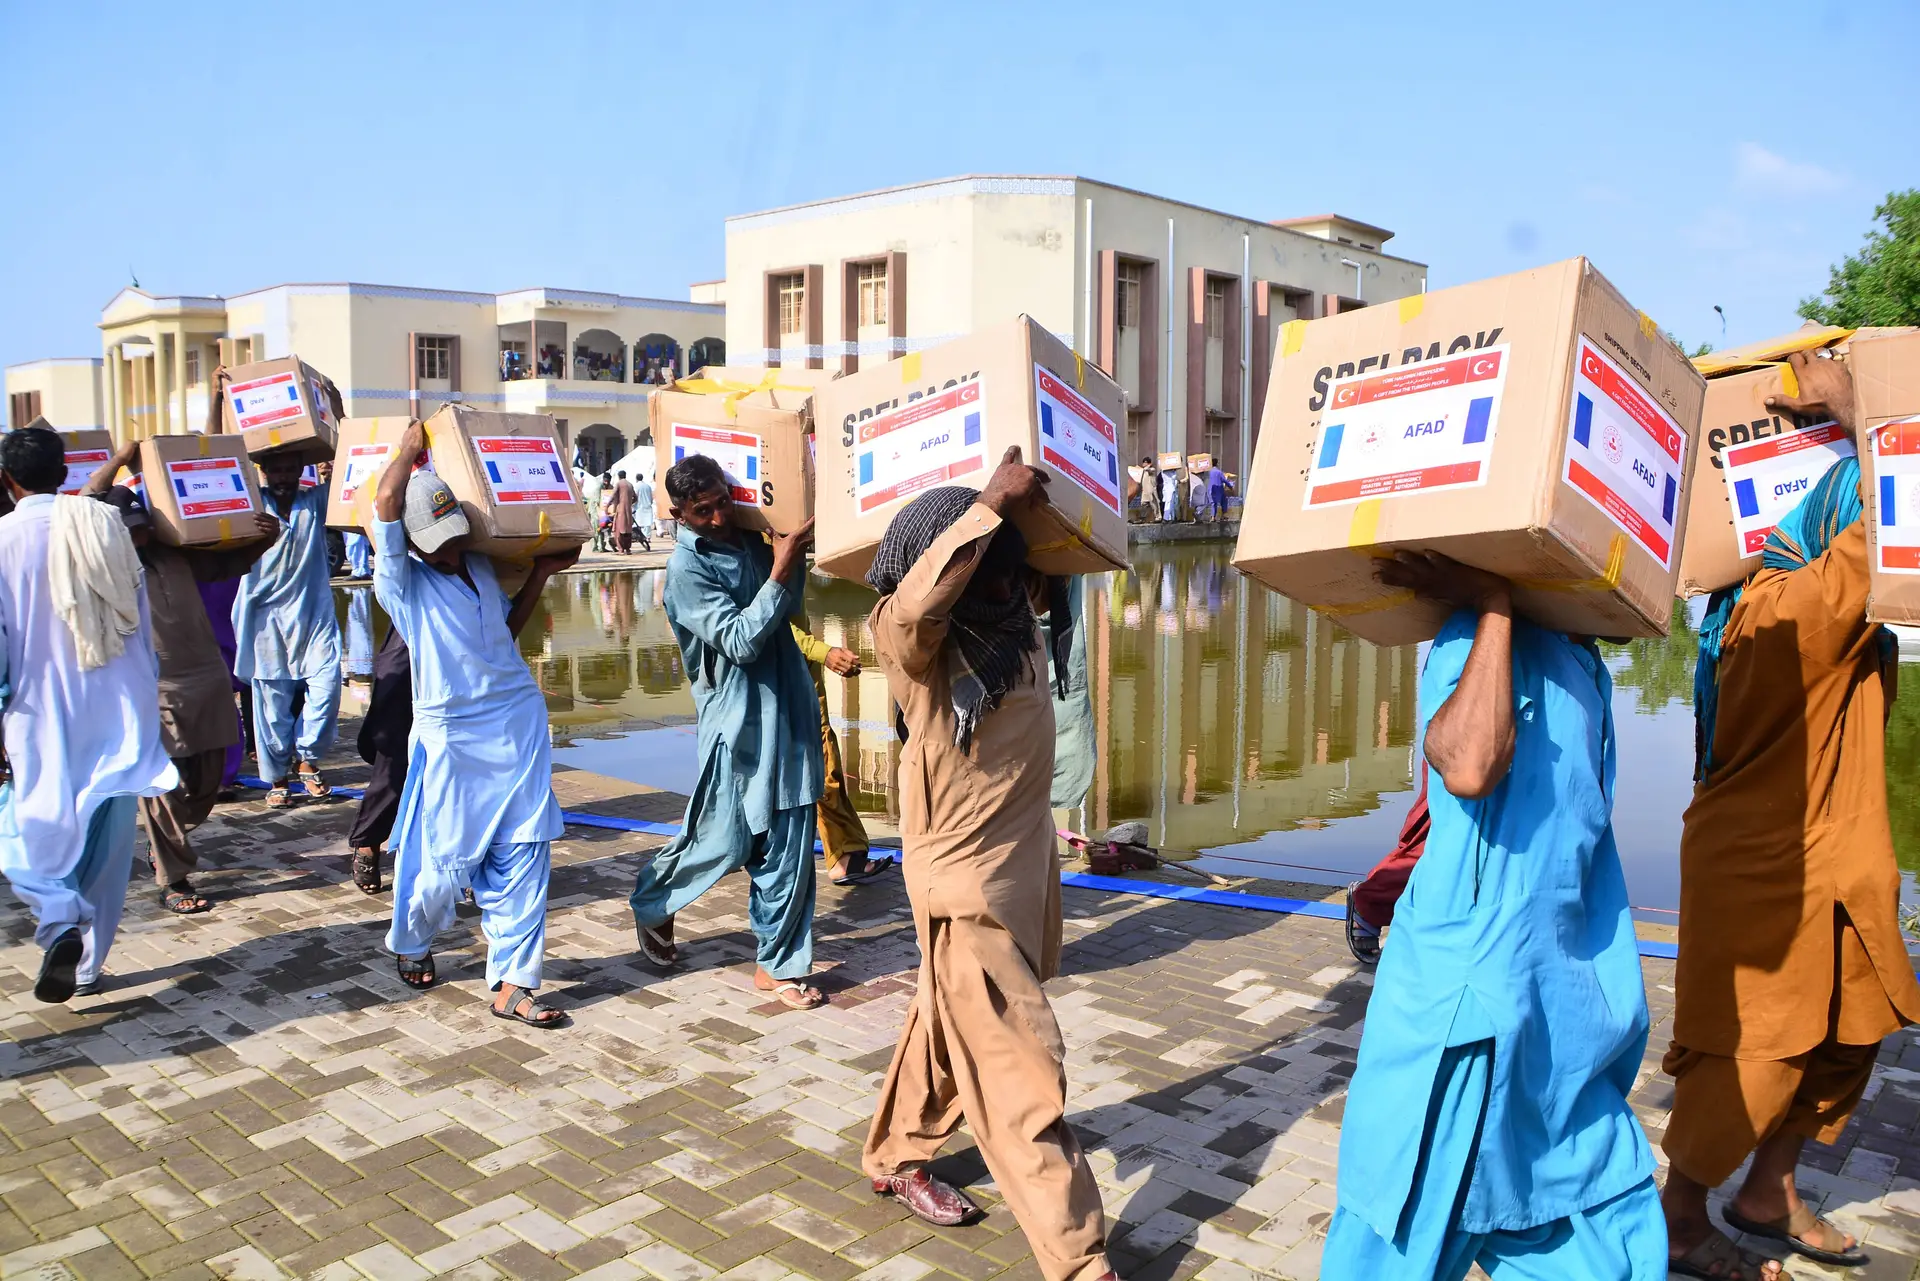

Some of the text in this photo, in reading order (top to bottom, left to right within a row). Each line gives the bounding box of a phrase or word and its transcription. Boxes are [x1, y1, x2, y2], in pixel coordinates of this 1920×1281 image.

[1604, 332, 1651, 382] SHIPPING SECTION
[1404, 419, 1445, 439] AFAD
[920, 433, 949, 451] AFAD
[1084, 442, 1101, 462] AFAD
[529, 467, 546, 475] AFAD
[1632, 458, 1656, 488] AFAD
[1774, 477, 1808, 496] AFAD
